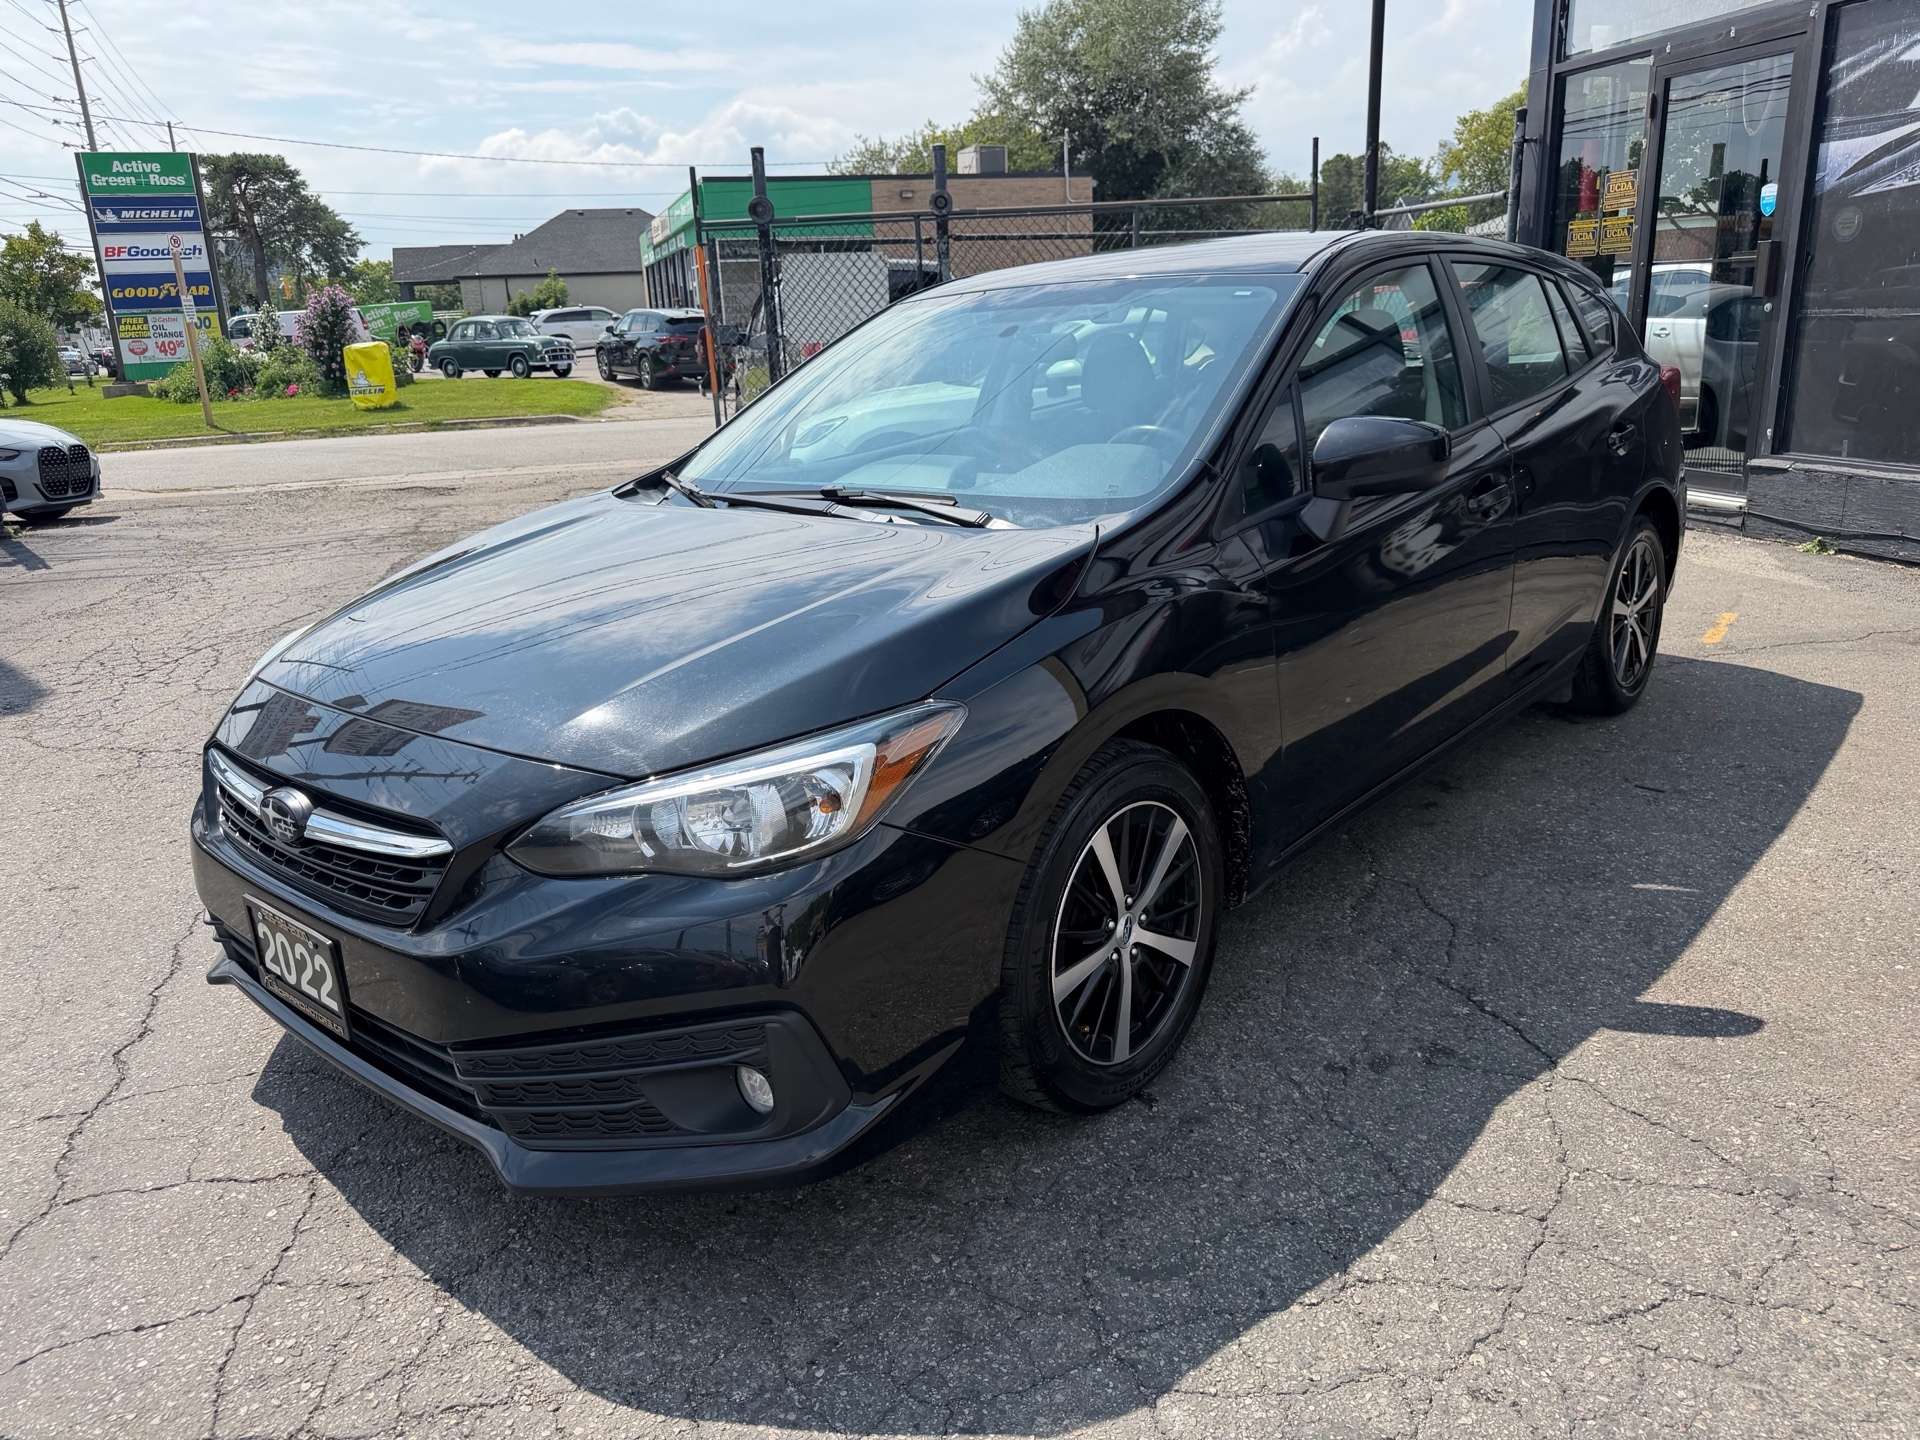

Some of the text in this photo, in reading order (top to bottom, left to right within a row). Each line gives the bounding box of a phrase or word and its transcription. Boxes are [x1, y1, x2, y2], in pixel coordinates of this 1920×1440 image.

[112, 160, 161, 173] Active
[1609, 181, 1633, 193] UCDA
[120, 209, 195, 219] MICHELIN
[1572, 231, 1593, 241] UCDA
[1606, 228, 1629, 238] UCDA
[104, 244, 203, 258] BFGoodch
[112, 285, 210, 298] GOODYAR
[257, 922, 339, 1012] 2022
